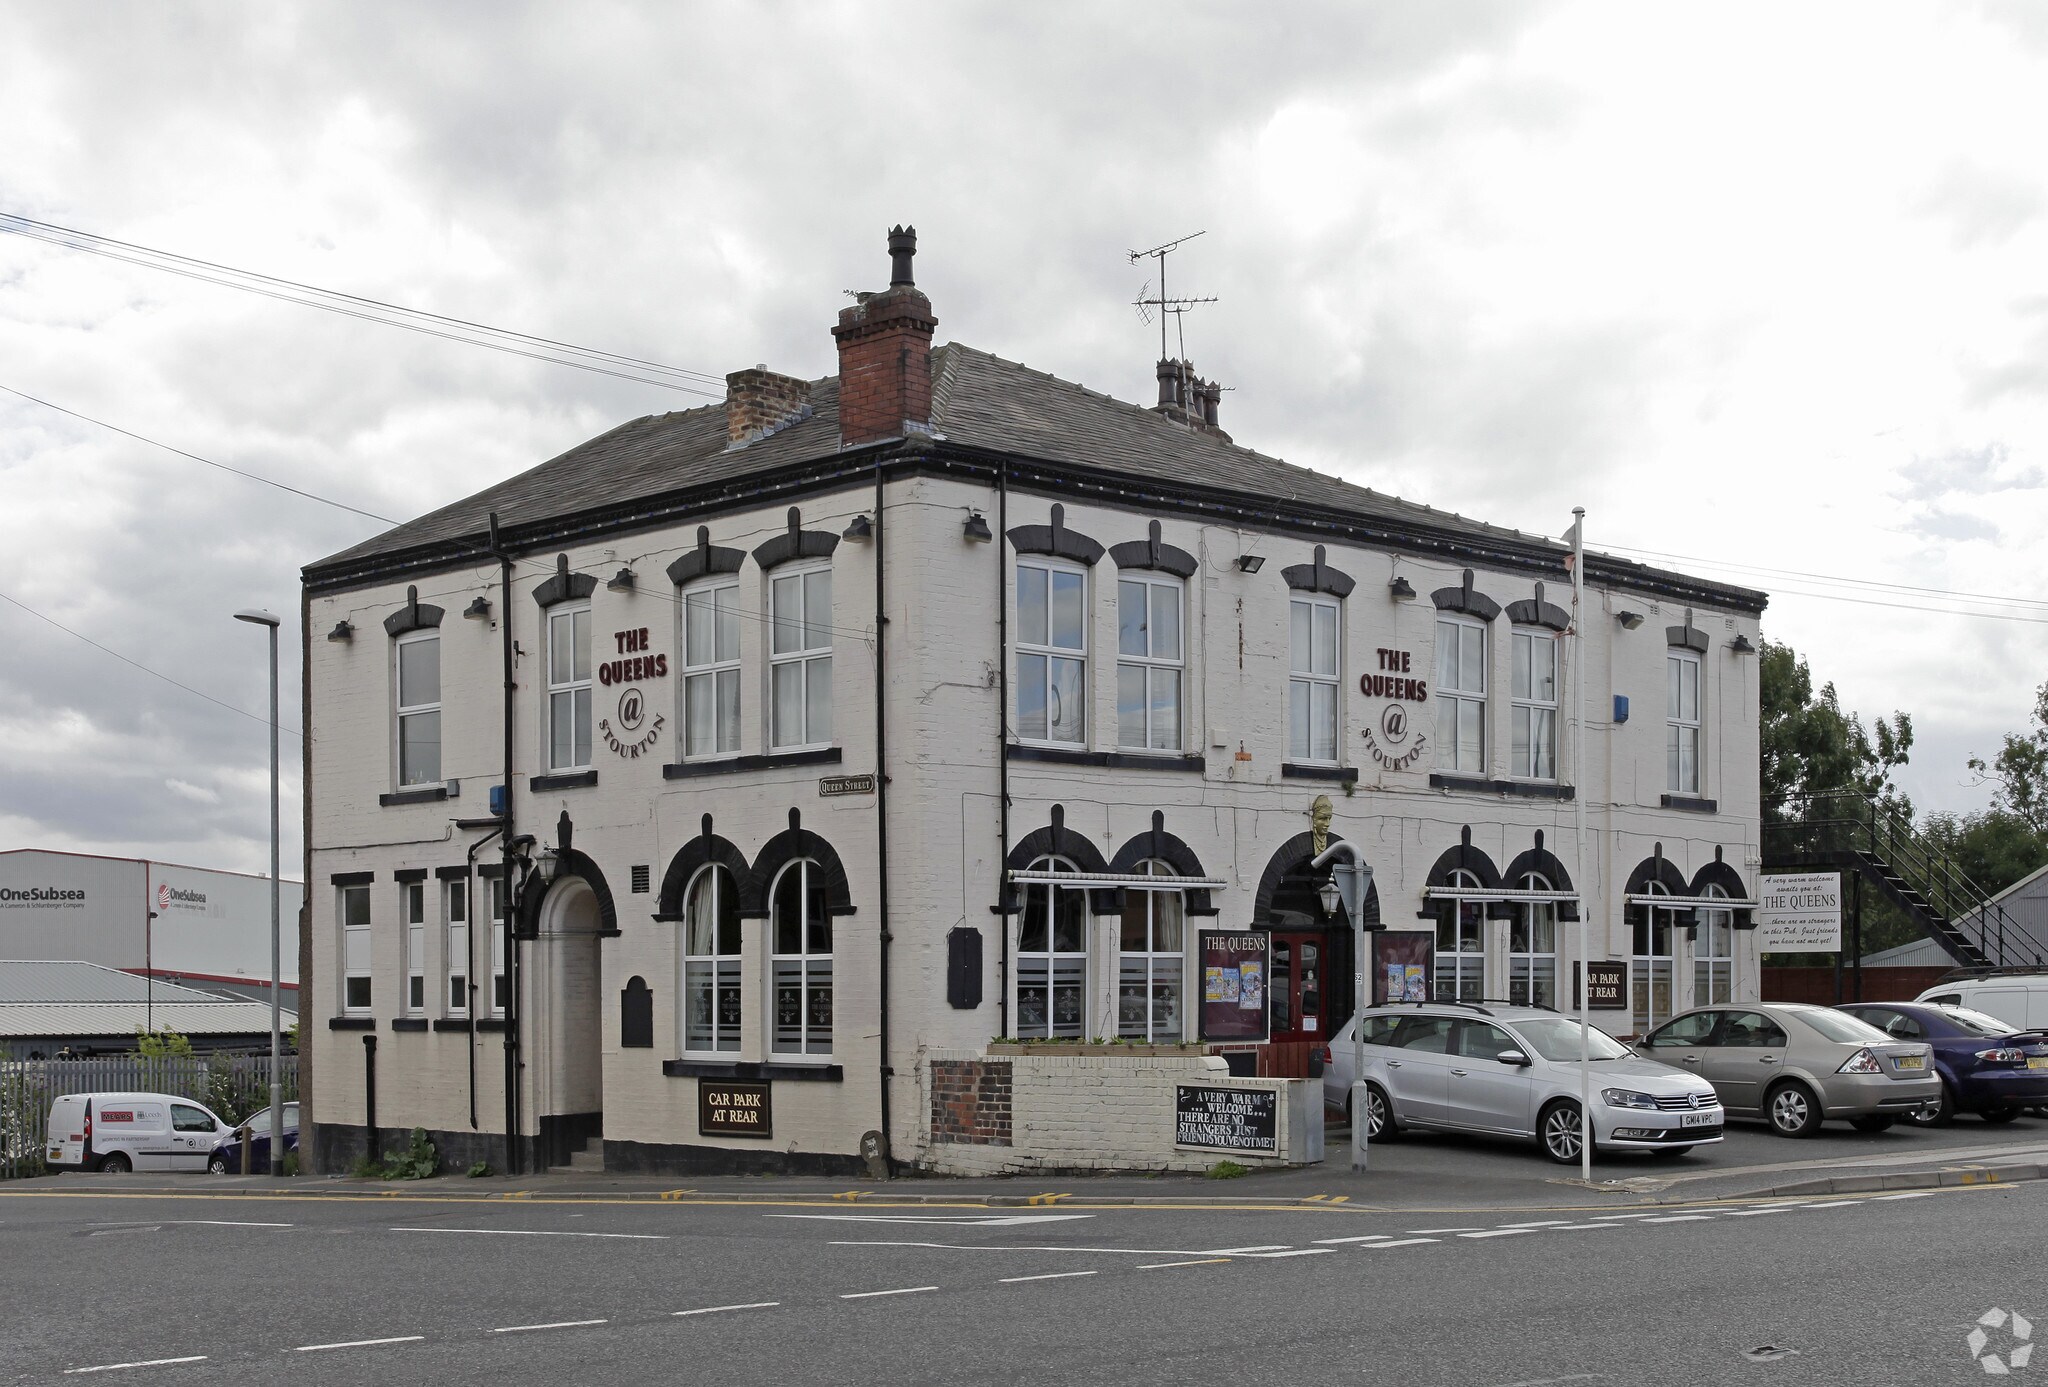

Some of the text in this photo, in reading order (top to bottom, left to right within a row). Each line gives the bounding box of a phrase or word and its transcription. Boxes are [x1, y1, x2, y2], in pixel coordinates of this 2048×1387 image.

[615, 627, 648, 654] THE
[1377, 648, 1411, 673] THE
[599, 653, 668, 686] QUEENS
[1360, 673, 1428, 703] QUEENS
[618, 687, 645, 731] @
[1382, 703, 1408, 744] @
[599, 713, 665, 759] STOURTON
[1362, 727, 1427, 770] STOURTON
[1764, 876, 1772, 884] A
[0, 887, 85, 900] OneSubsea
[170, 888, 206, 903] OneSubsea
[31, 902, 62, 910] Schlumberger
[63, 902, 85, 910] Company
[1764, 894, 1836, 910] THE QUEENS
[1808, 918, 1836, 926] strangers
[1801, 926, 1816, 936] Just
[1816, 926, 1838, 936] friends
[1205, 936, 1266, 953] THE QUEENS
[1587, 974, 1620, 984] AR PARK
[1596, 987, 1617, 998] REAR
[709, 1093, 761, 1107] CAR PARK
[1196, 1092, 1260, 1106] A VERY WARM
[103, 1112, 131, 1120] MEARS
[712, 1110, 758, 1123] AT REAR
[1178, 1111, 1245, 1126] THERE ARE NO
[1179, 1122, 1258, 1137] STRANGERS JUST
